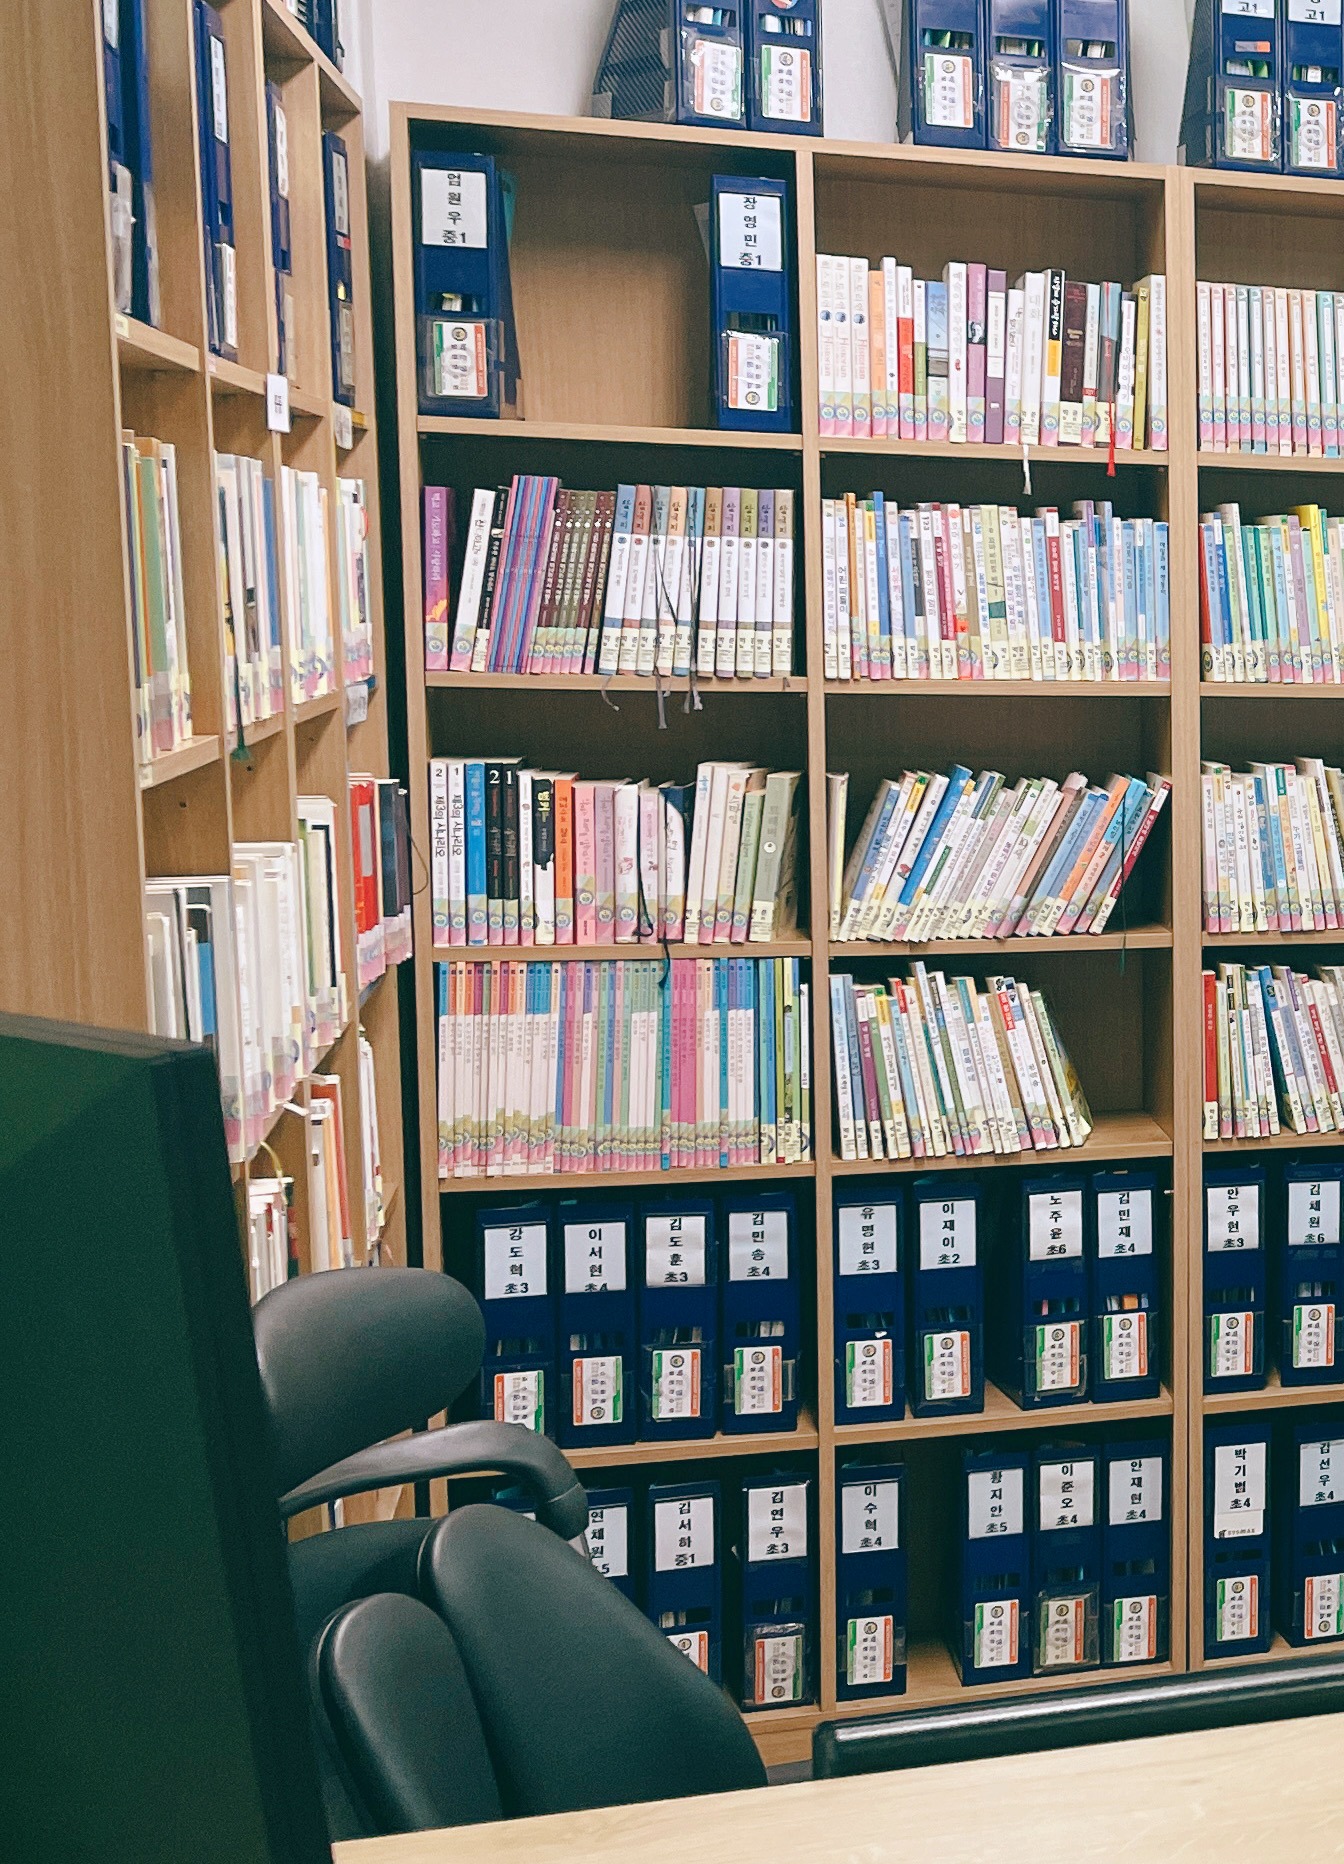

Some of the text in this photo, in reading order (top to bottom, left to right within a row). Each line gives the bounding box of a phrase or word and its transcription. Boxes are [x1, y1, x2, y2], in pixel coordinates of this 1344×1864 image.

[1305, 9, 1325, 22] 고1
[744, 196, 758, 248] 장영민
[442, 229, 466, 244] 중1
[738, 251, 762, 266] 중1
[490, 770, 500, 784] 2
[506, 770, 513, 785] 1
[452, 794, 462, 818] 제3의
[434, 768, 446, 858] 2 제3의 시나리오
[452, 820, 462, 857] 시나리오
[1116, 1191, 1130, 1237] 김민재
[1228, 1188, 1239, 1232] 안우현
[940, 1201, 954, 1248] 이재이
[668, 1216, 683, 1266] 김도훈
[1223, 1238, 1246, 1250] 초3
[1304, 1233, 1324, 1244] 초6
[589, 1228, 602, 1277] 이서현
[1046, 1244, 1066, 1255] 초6
[1115, 1243, 1134, 1253] 초4
[858, 1260, 879, 1270] 초3
[939, 1254, 959, 1264] 초2
[664, 1272, 688, 1282] 초3
[747, 1267, 769, 1277] 초4
[505, 1283, 528, 1294] 초3
[1317, 1441, 1330, 1486] 김선우
[1235, 1448, 1246, 1493] 박기범
[1061, 1464, 1074, 1508] 이준오
[1230, 1498, 1250, 1509] 초4
[1315, 1491, 1336, 1503] 초4
[770, 1491, 784, 1538] 김연우
[1056, 1515, 1079, 1527] 초4
[1126, 1510, 1146, 1520] 초4
[676, 1500, 691, 1547] 김서하
[986, 1522, 1007, 1533] 초5
[767, 1543, 788, 1554] 초3
[860, 1537, 881, 1548] 초4
[675, 1554, 694, 1566] 중1
